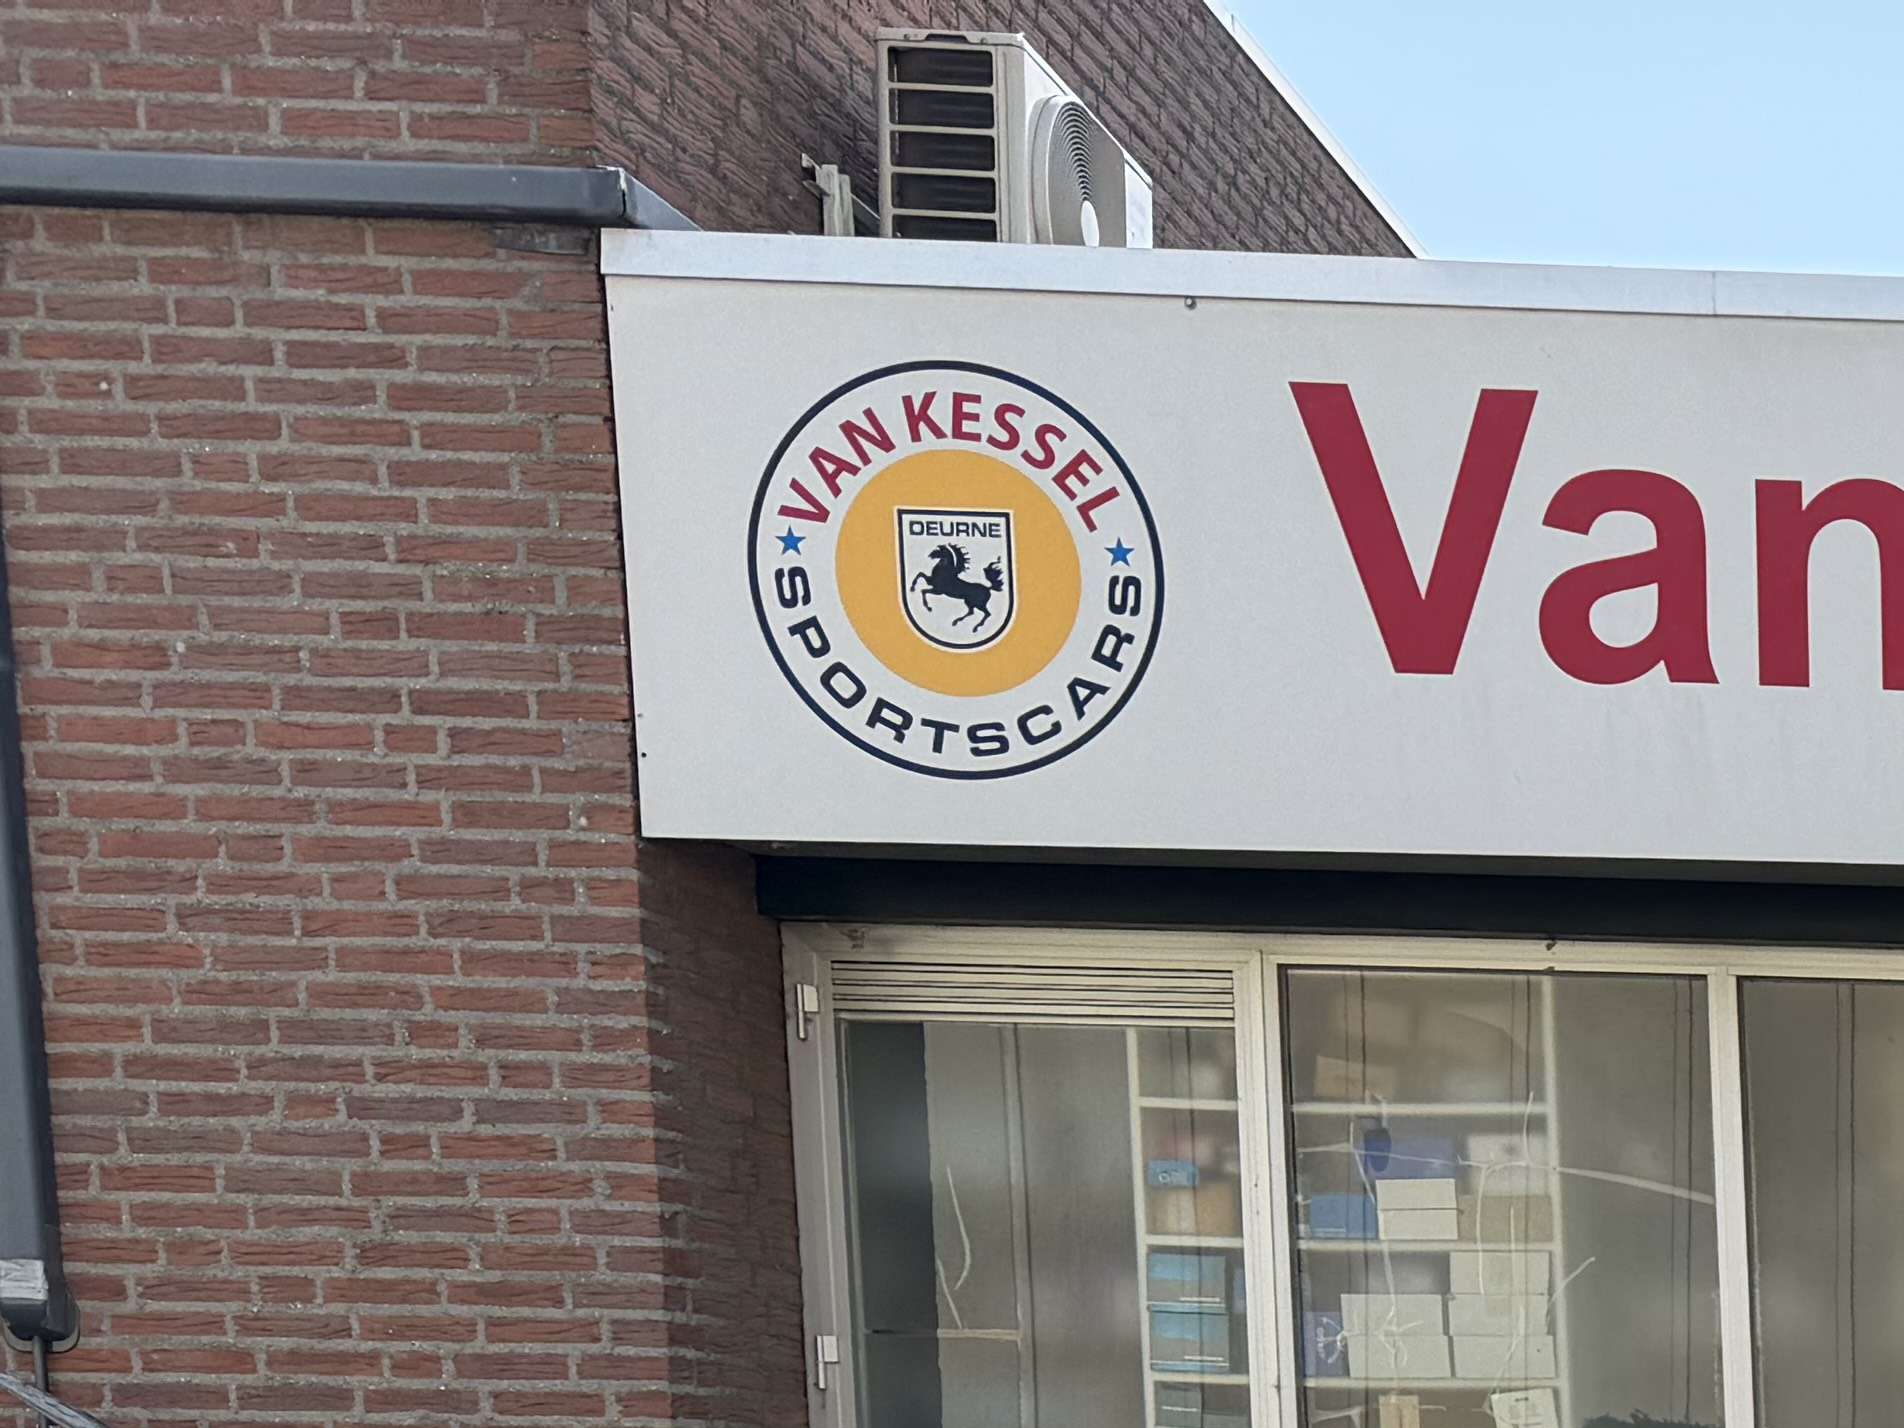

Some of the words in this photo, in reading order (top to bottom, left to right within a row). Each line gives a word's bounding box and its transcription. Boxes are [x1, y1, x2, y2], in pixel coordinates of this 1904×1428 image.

[777, 407, 897, 524] VAN
[901, 390, 1121, 533] KESSEL
[908, 519, 1003, 539] DEURNE
[774, 565, 1142, 758] SPORTSCARS
